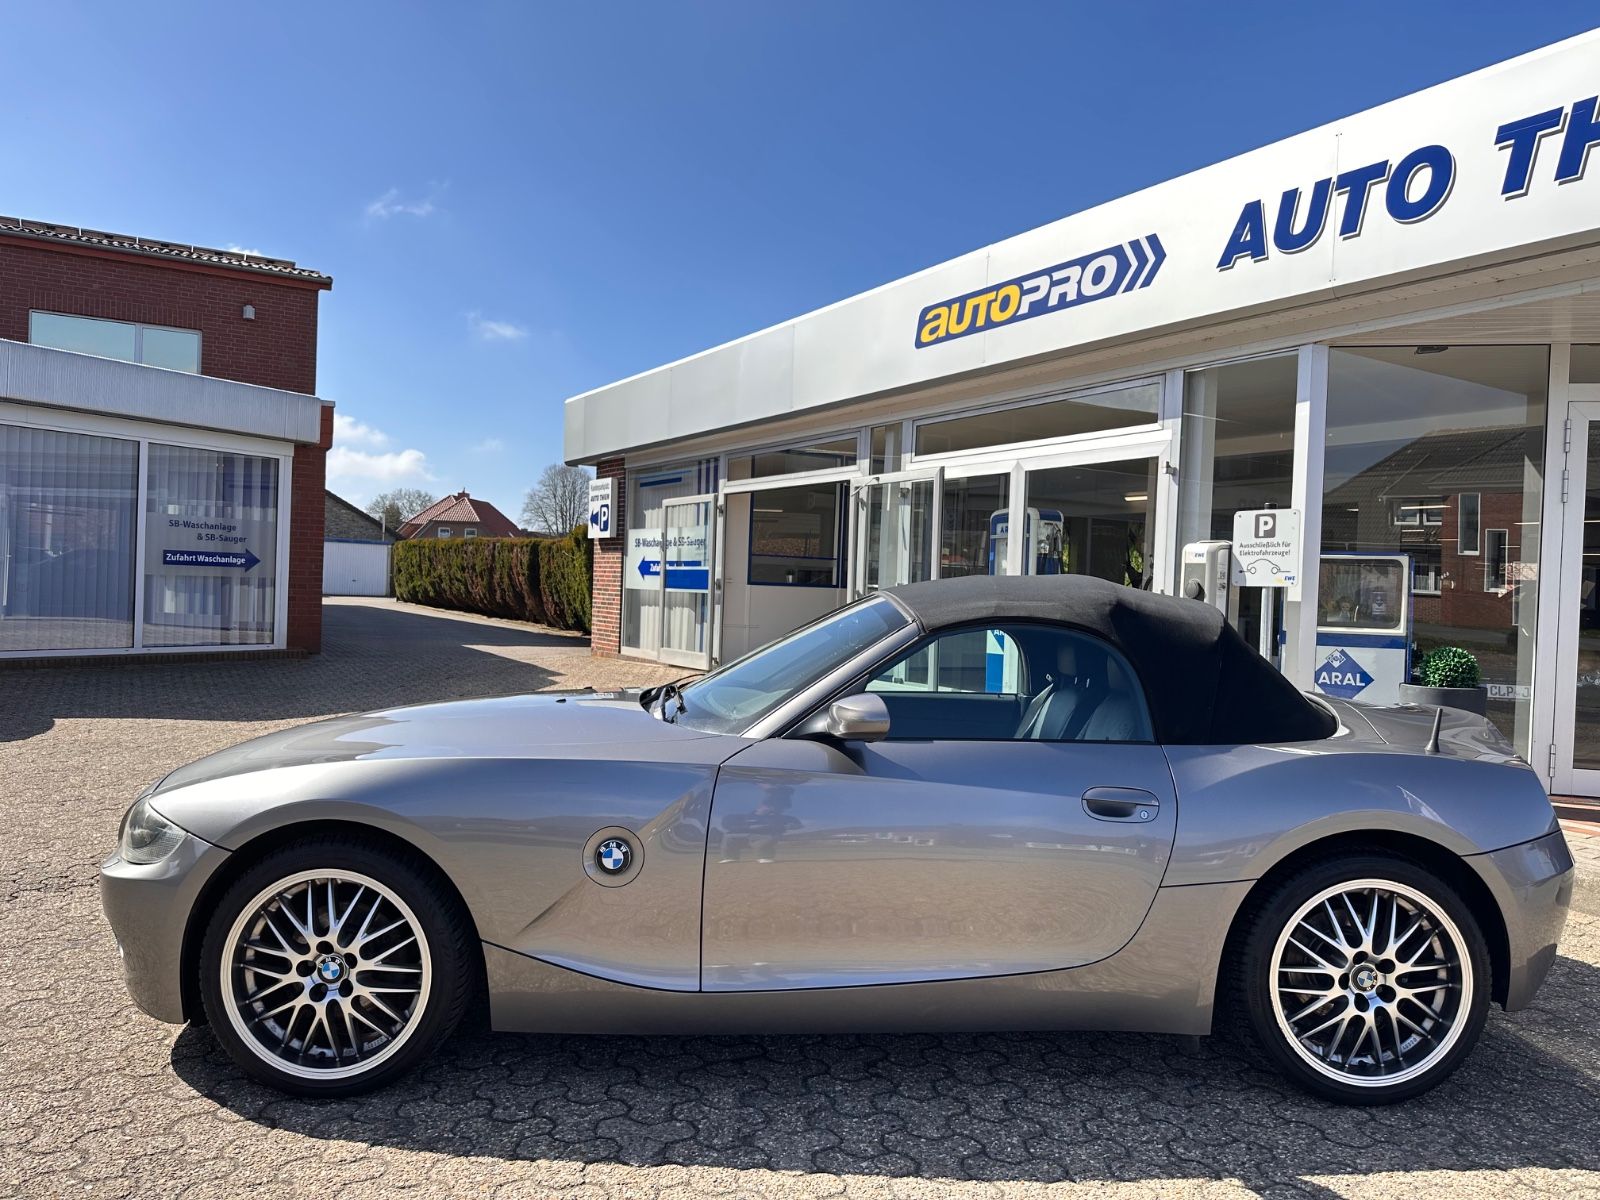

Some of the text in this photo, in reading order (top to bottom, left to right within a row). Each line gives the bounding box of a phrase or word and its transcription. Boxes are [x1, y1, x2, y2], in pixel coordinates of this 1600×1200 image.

[1215, 144, 1457, 272] AUTO
[168, 519, 237, 532] SB-Waschanlage
[1258, 515, 1274, 537] P
[196, 532, 204, 541] &
[165, 553, 246, 565] Zufahrt Waschanlage
[1318, 671, 1366, 687] ARAL
[599, 841, 628, 853] BMW
